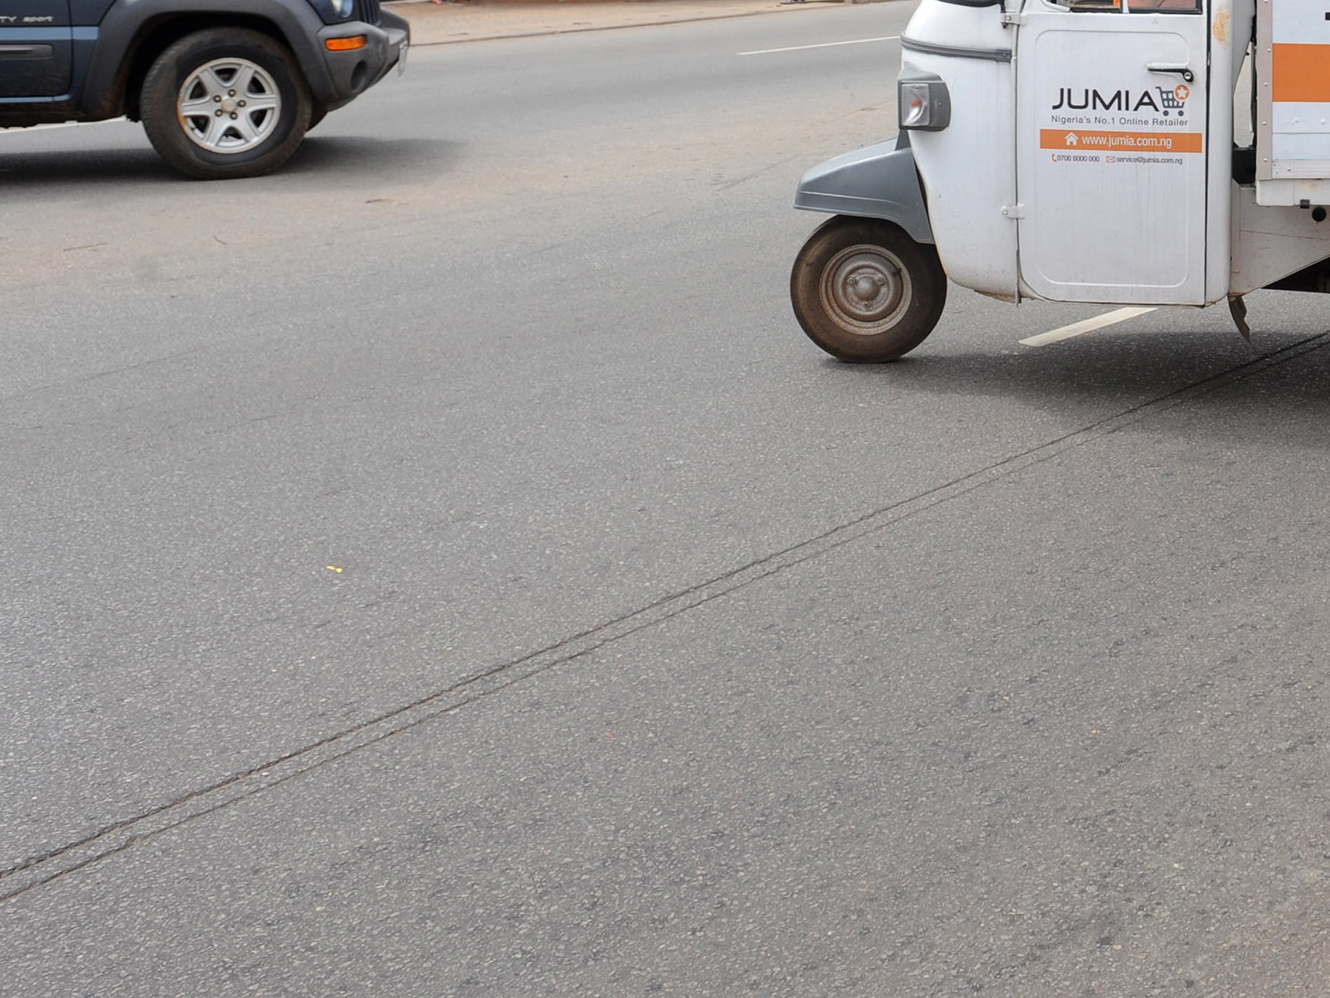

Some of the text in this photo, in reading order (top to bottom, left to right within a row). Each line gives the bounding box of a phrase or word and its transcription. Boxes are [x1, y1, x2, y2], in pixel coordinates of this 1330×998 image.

[1051, 86, 1160, 112] JUMIA
[1051, 114, 1189, 127] Nigeria's No.1 Online Retailer
[1081, 135, 1173, 149] www.jumia.com.ng
[1056, 154, 1101, 164] 0700 6000 000
[1116, 156, 1184, 166] service@jumia.com.ng
